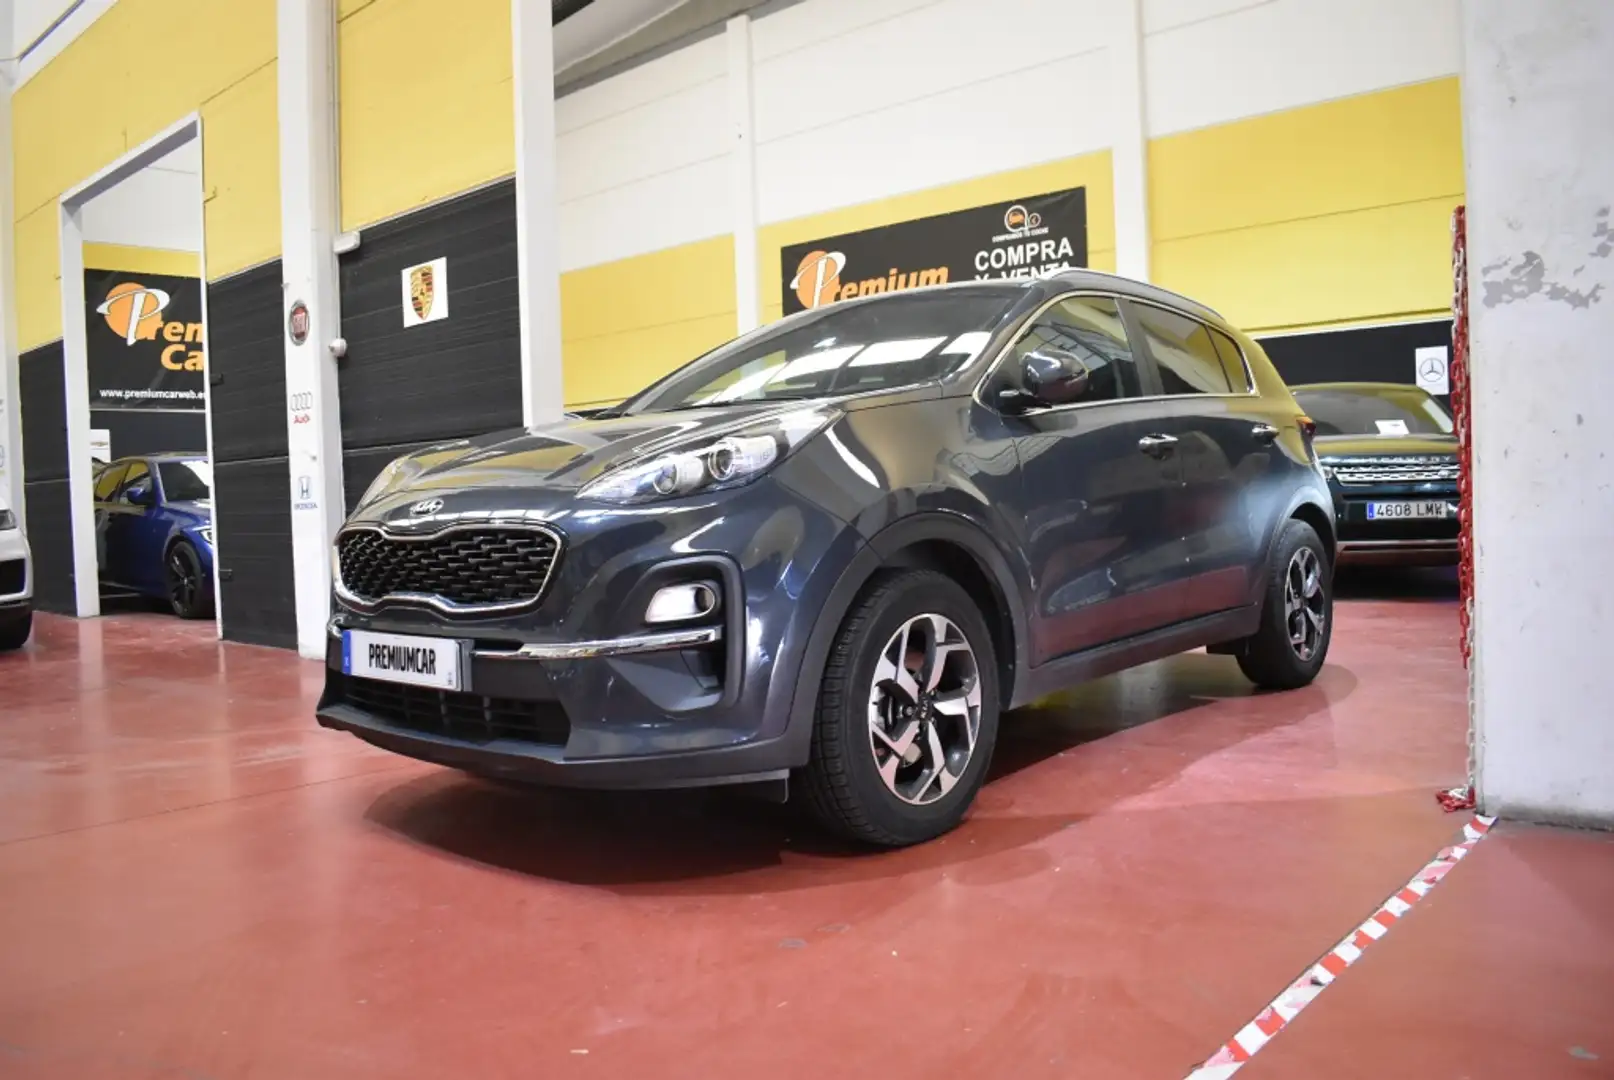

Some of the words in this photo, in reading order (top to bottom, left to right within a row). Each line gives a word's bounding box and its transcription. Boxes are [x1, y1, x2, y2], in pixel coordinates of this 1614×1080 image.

[974, 237, 1075, 271] COMPRA
[790, 251, 949, 310] Premium
[161, 343, 205, 372] Ca
[1377, 503, 1412, 517] 4608
[368, 643, 436, 675] PREMIUMCAR
